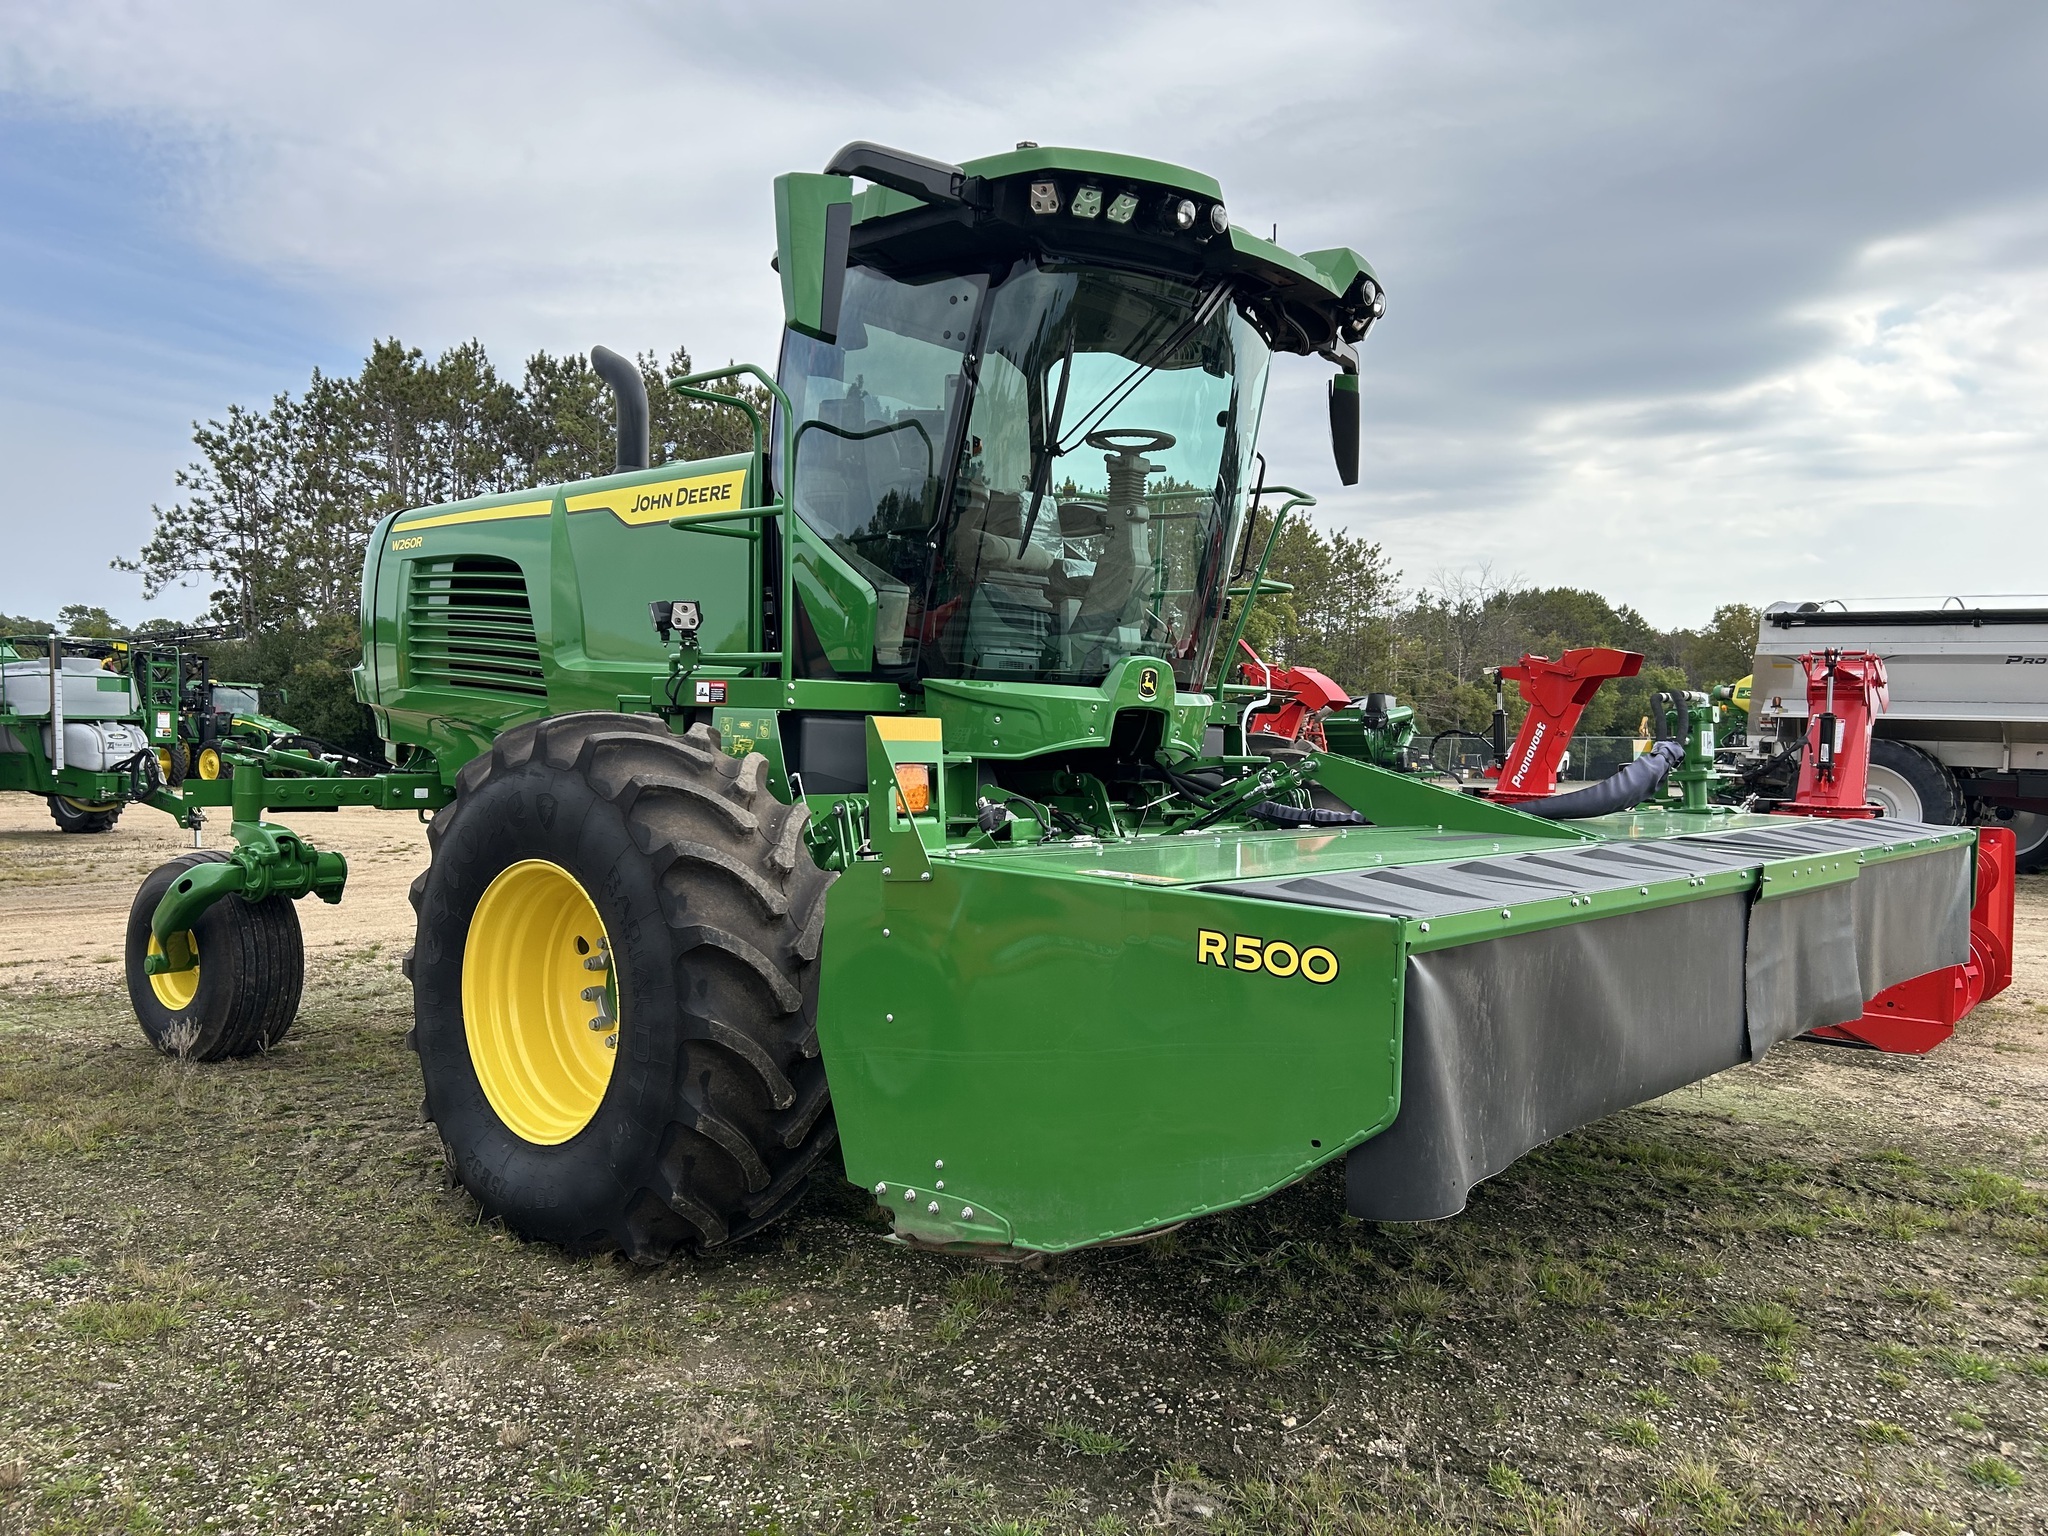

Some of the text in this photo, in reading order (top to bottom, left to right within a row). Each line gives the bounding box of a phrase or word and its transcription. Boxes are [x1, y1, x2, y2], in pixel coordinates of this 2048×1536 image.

[631, 483, 732, 513] JOHN DEERE
[392, 536, 423, 551] W260R
[1511, 721, 1546, 789] Pronovost
